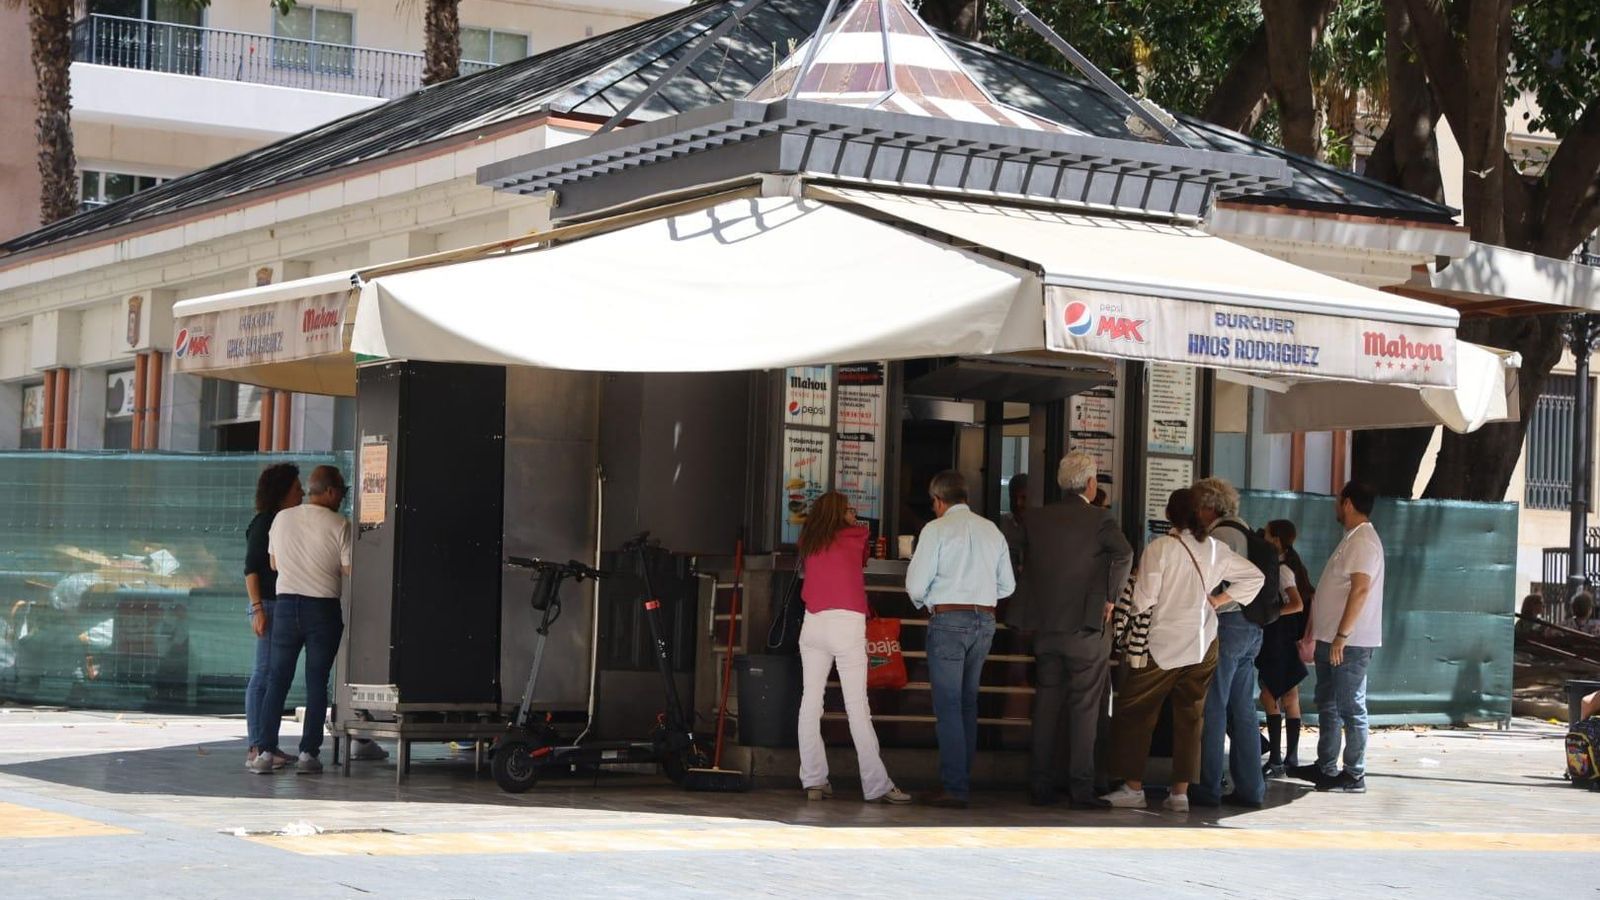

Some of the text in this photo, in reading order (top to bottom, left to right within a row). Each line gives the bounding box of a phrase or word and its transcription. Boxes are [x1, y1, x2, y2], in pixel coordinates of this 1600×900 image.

[1100, 303, 1122, 313] pepsi
[1096, 315, 1145, 343] MAX
[1214, 312, 1295, 335] BURGUER
[1188, 333, 1320, 368] HNOS RODRIGUEZ
[1363, 331, 1444, 361] Mahou
[791, 375, 827, 391] Mahou
[801, 405, 826, 416] pepsi
